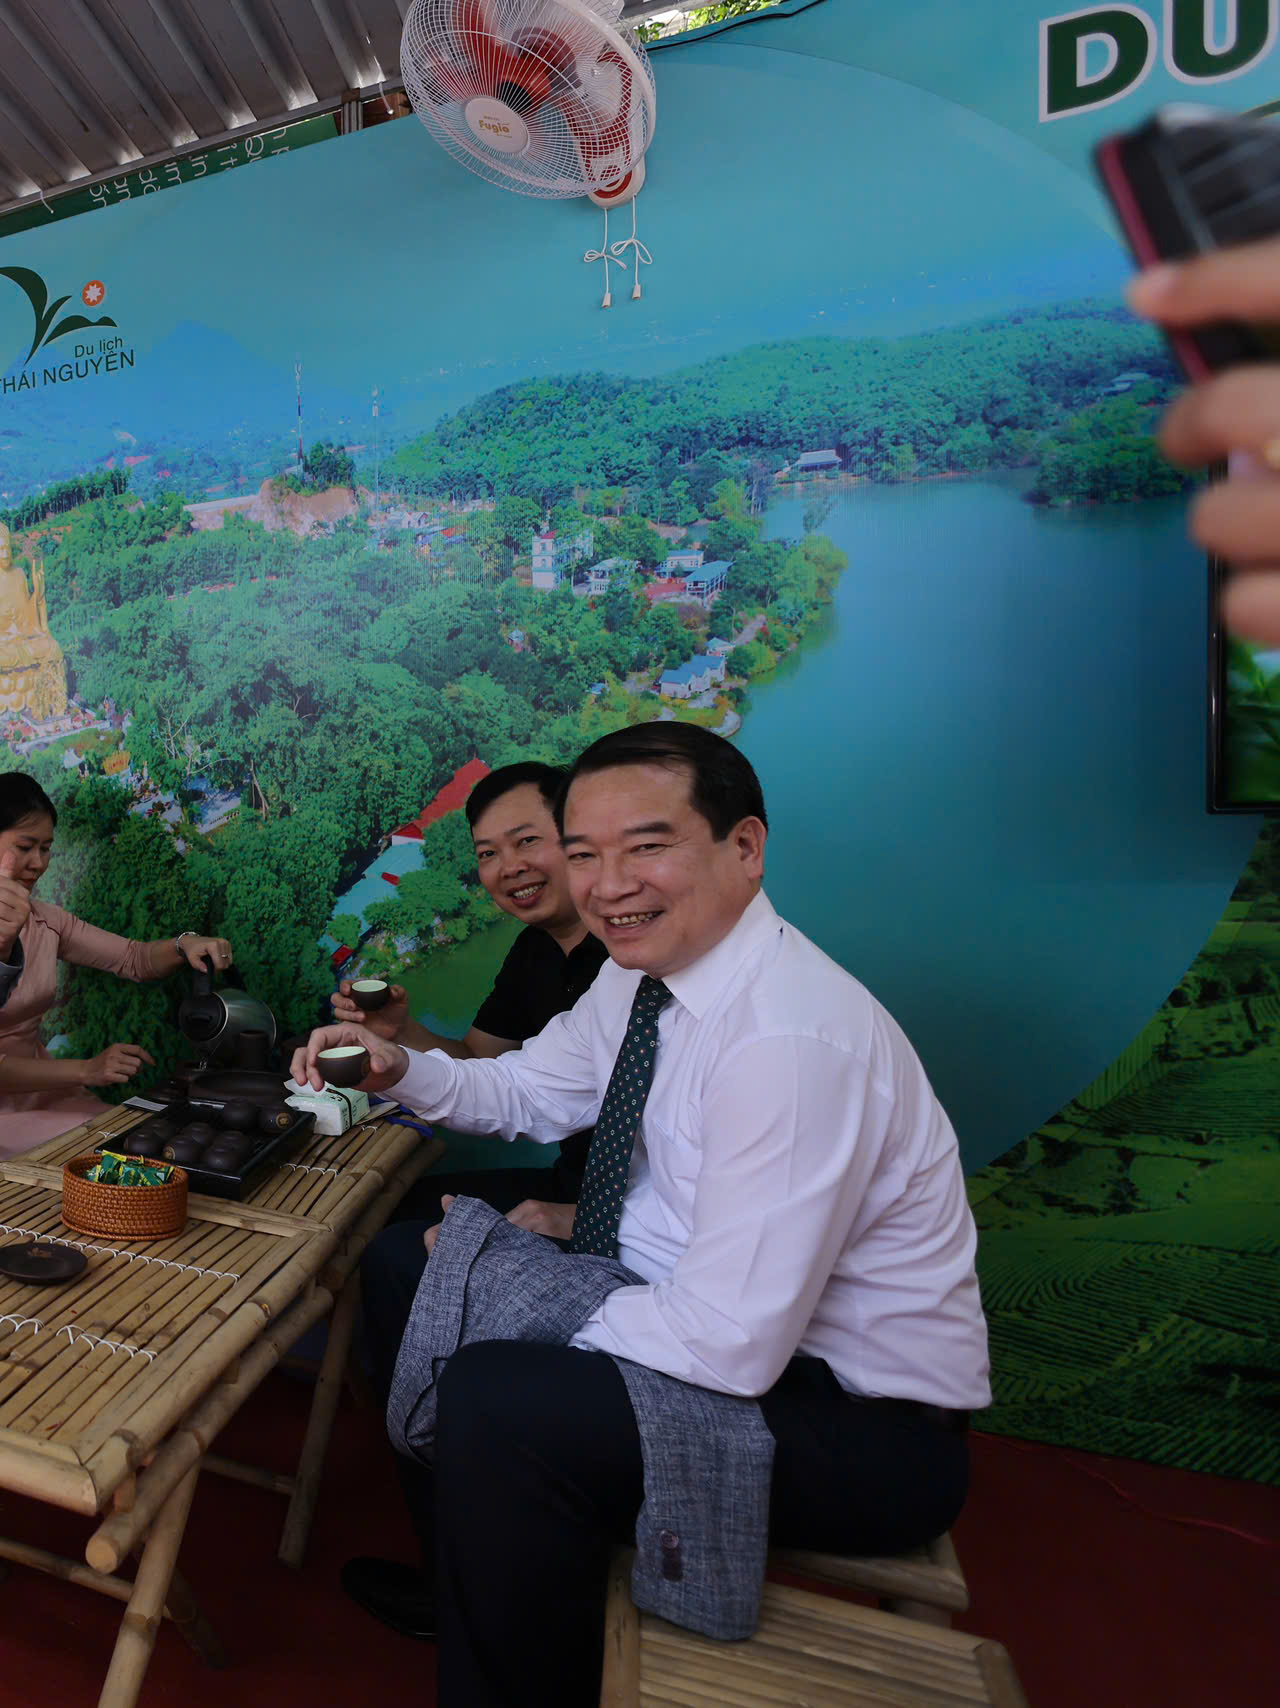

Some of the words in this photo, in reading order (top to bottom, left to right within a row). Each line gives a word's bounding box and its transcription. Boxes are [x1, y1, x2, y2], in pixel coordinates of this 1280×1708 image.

[1039, 0, 1279, 123] DU
[74, 344, 94, 358] Du
[99, 336, 123, 355] lịch
[43, 350, 135, 386] NGUYÊN
